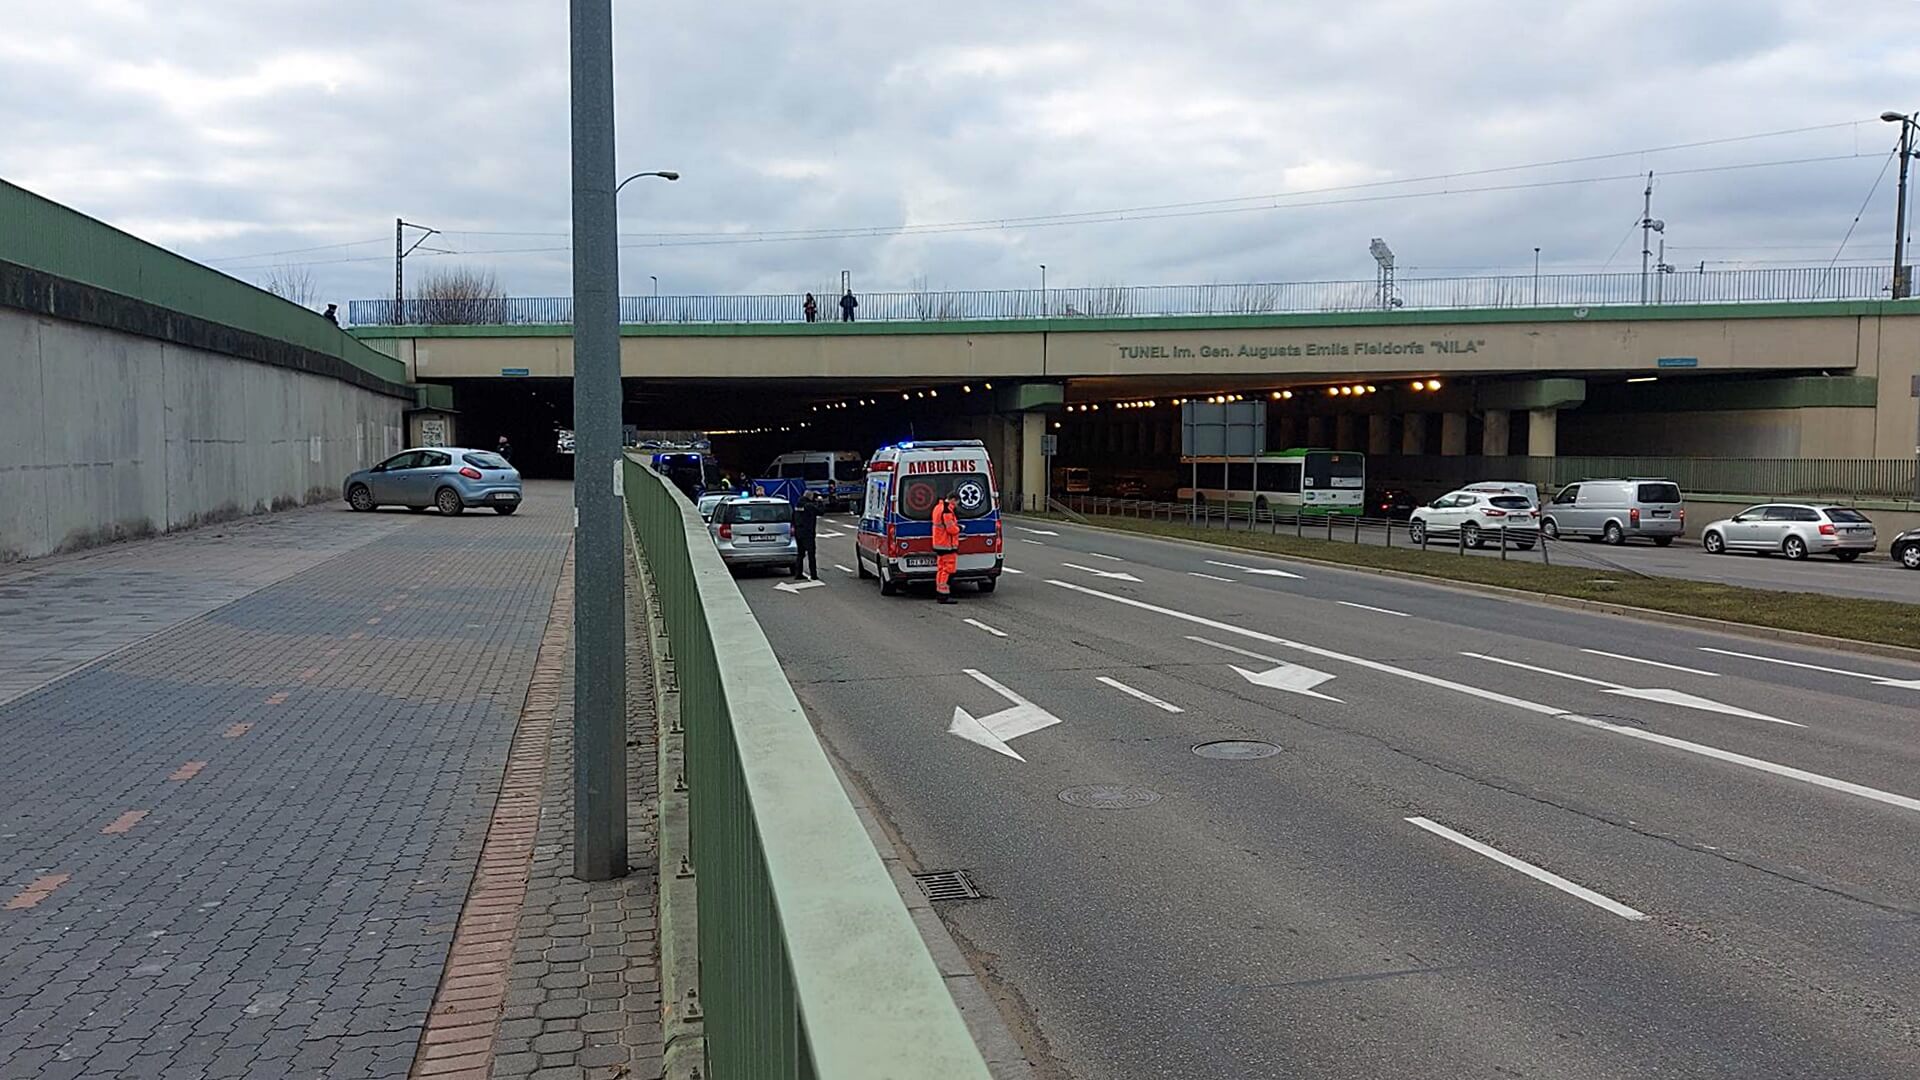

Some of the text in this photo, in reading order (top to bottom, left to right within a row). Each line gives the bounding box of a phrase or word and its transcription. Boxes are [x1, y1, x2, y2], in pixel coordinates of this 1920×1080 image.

[1119, 346, 1169, 359] TUNEL
[1200, 345, 1234, 358] Gen.
[1237, 345, 1302, 359] Augusta
[1306, 344, 1349, 356] Emila
[1354, 342, 1425, 355] Fieldorfa
[1430, 340, 1485, 353] "NILA"
[908, 460, 976, 474] AMBULANS
